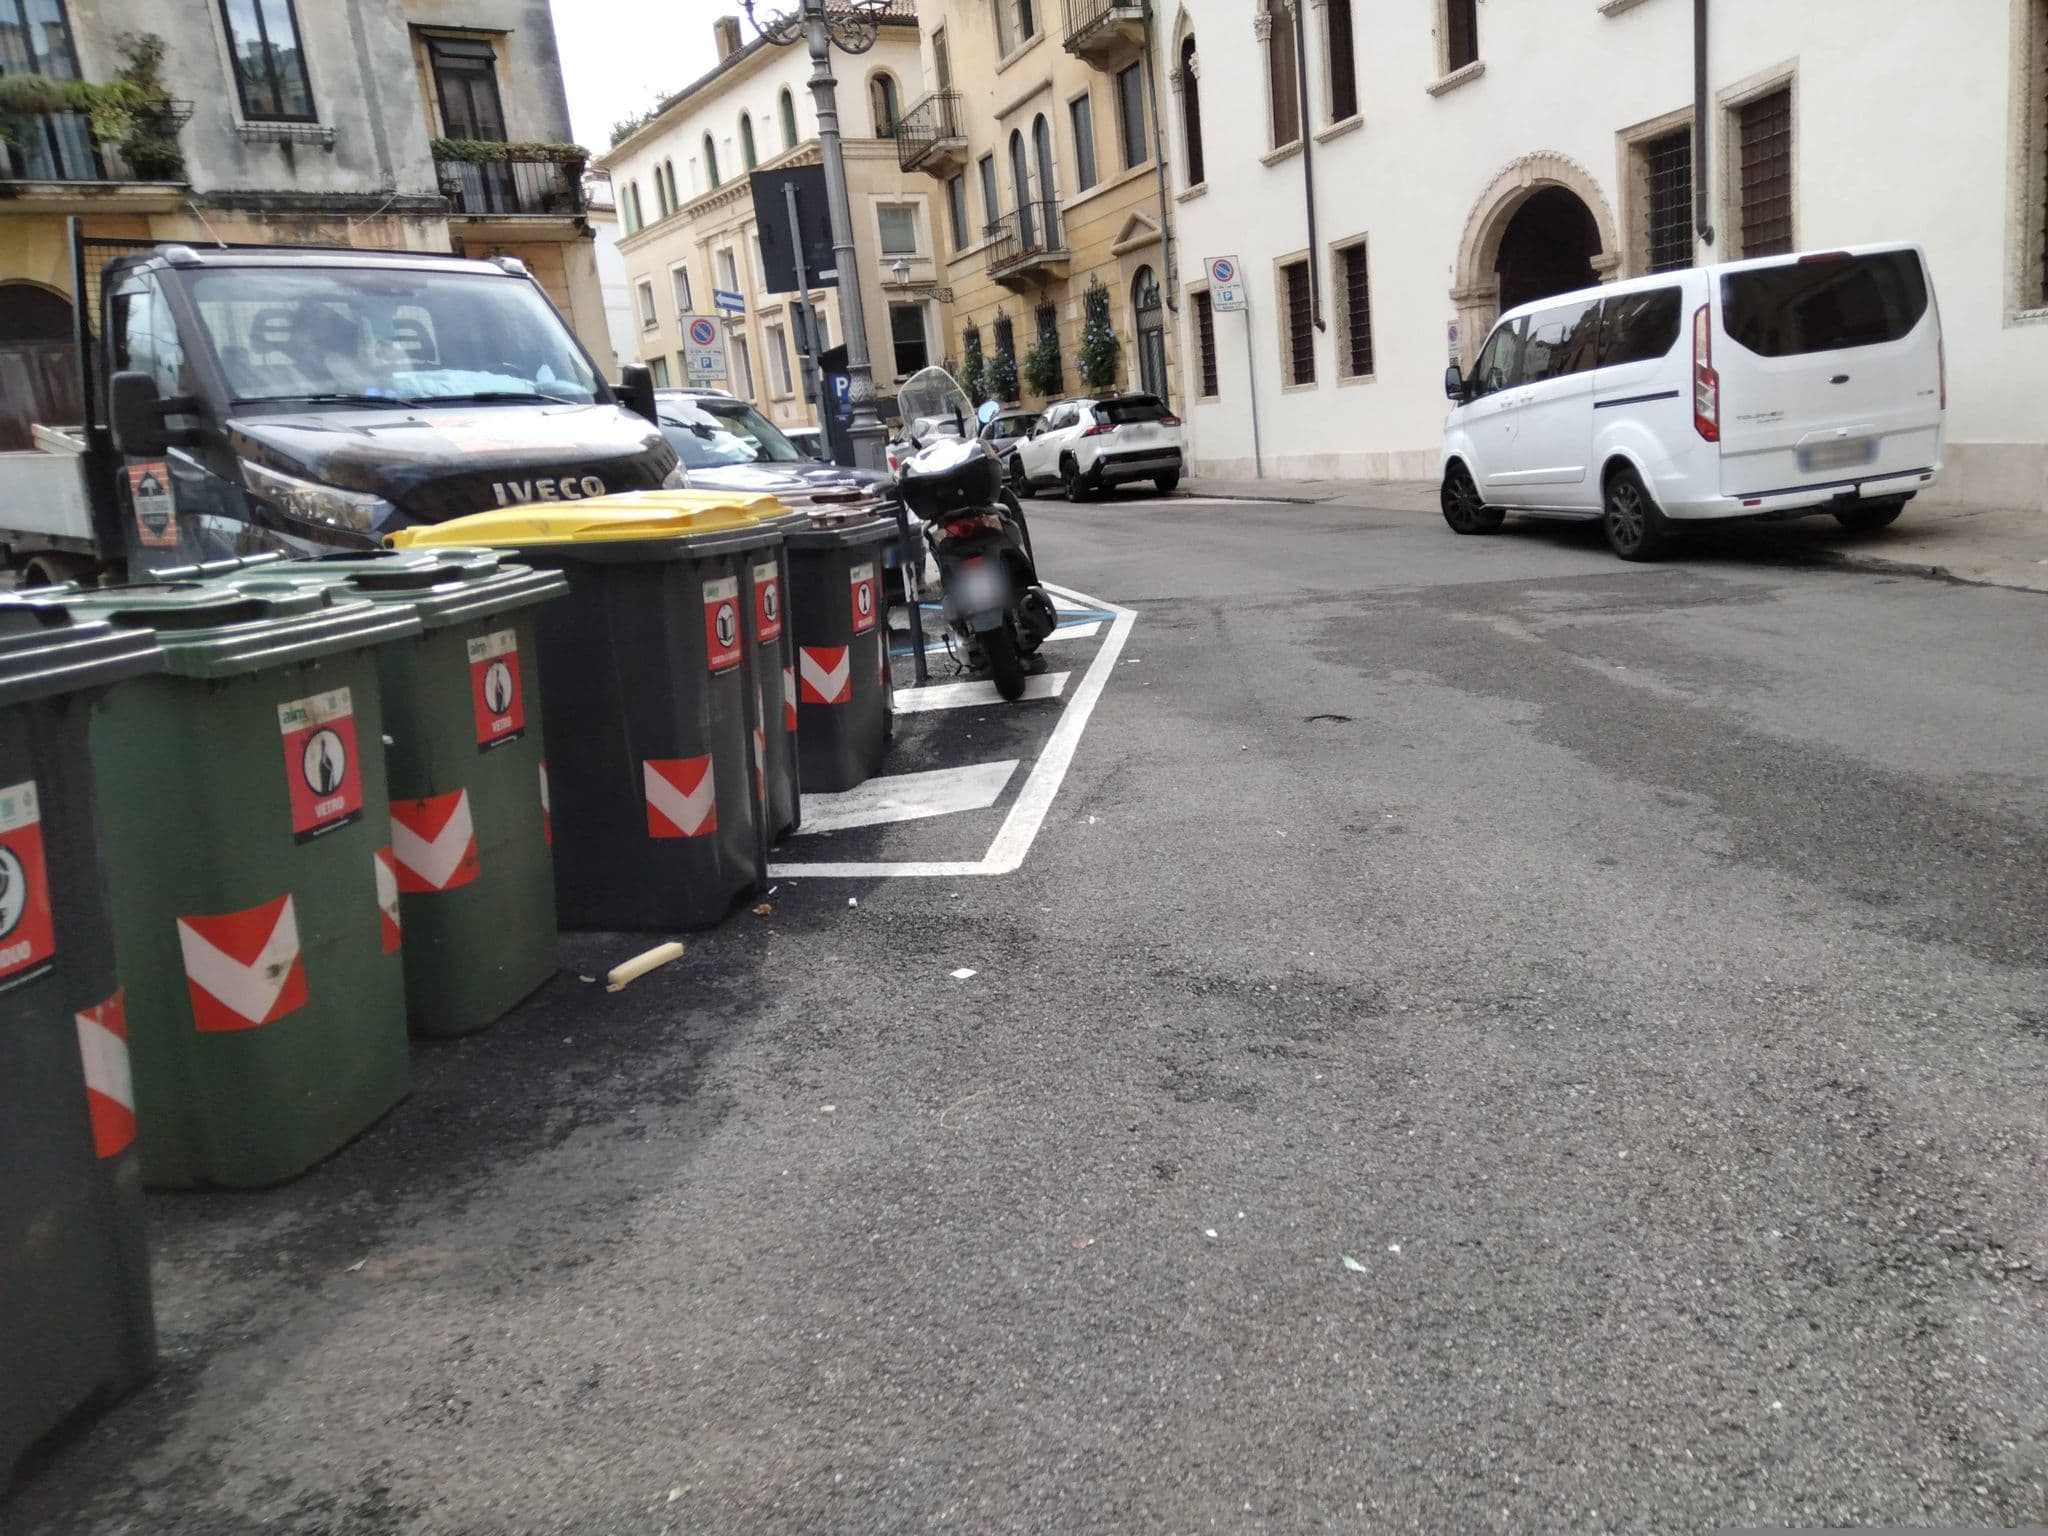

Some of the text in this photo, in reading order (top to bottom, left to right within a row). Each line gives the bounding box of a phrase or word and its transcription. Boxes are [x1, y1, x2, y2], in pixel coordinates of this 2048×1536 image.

[835, 376, 849, 397] P
[492, 475, 606, 506] IVECO
[314, 795, 346, 818] VETRO
